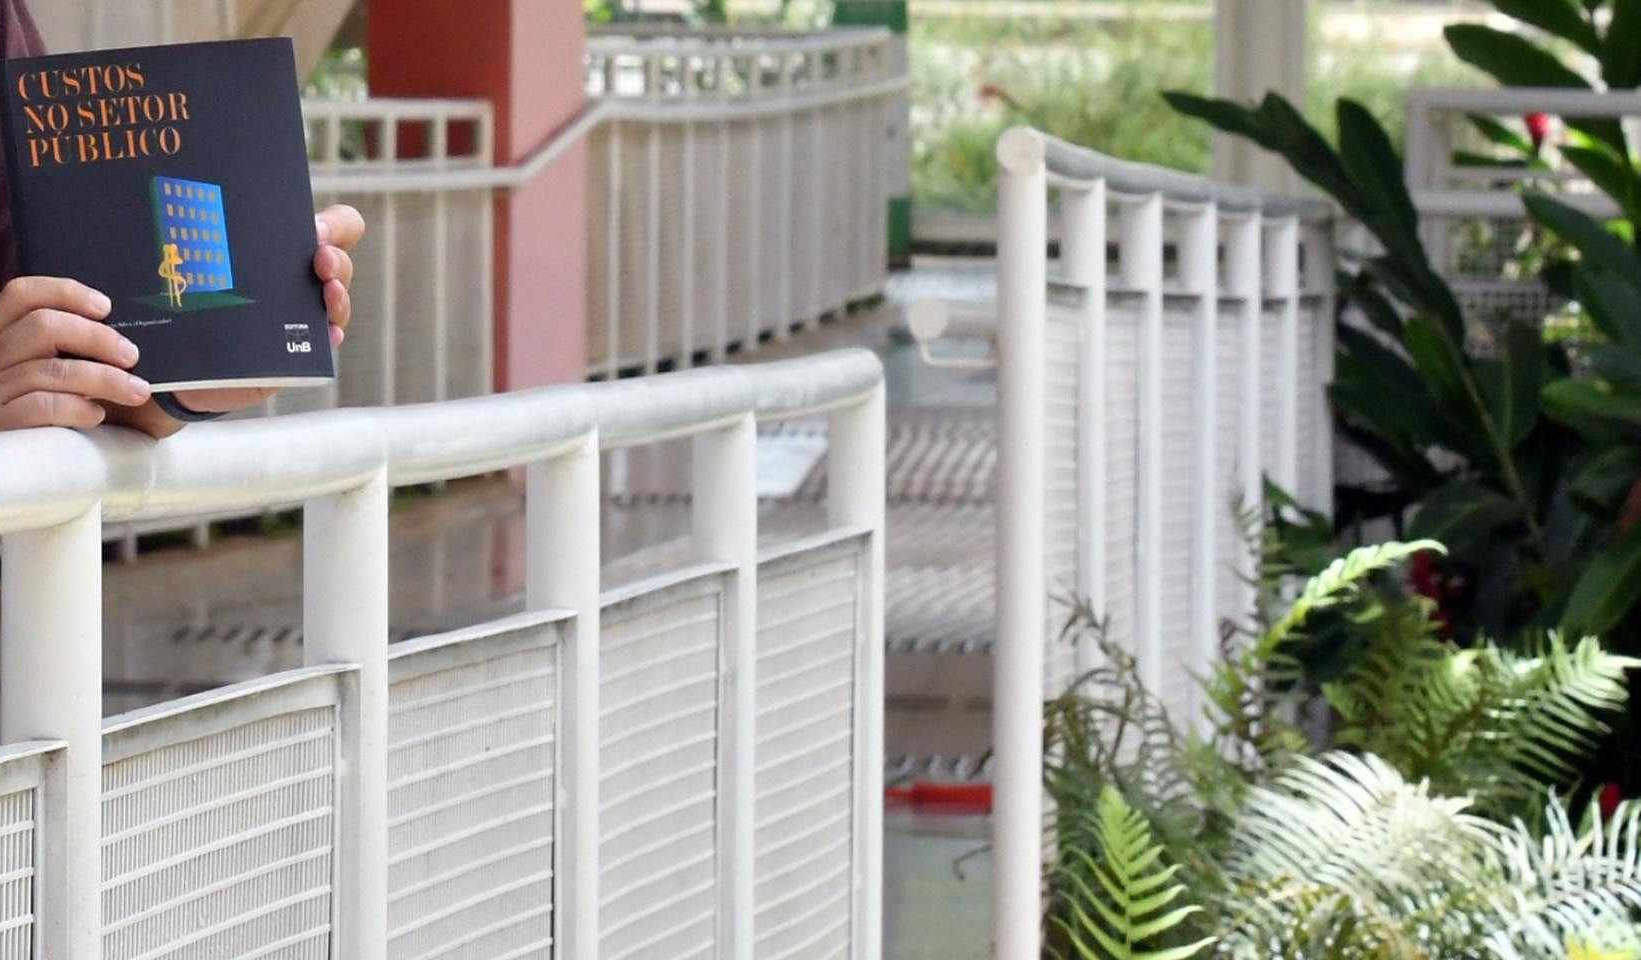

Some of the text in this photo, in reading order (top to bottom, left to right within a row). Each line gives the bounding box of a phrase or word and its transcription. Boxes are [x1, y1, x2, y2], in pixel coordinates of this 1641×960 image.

[18, 63, 145, 101] CUSTOS
[23, 92, 191, 134] NO SETOR
[28, 126, 182, 168] PÚBLICO
[286, 340, 312, 353] UnB
